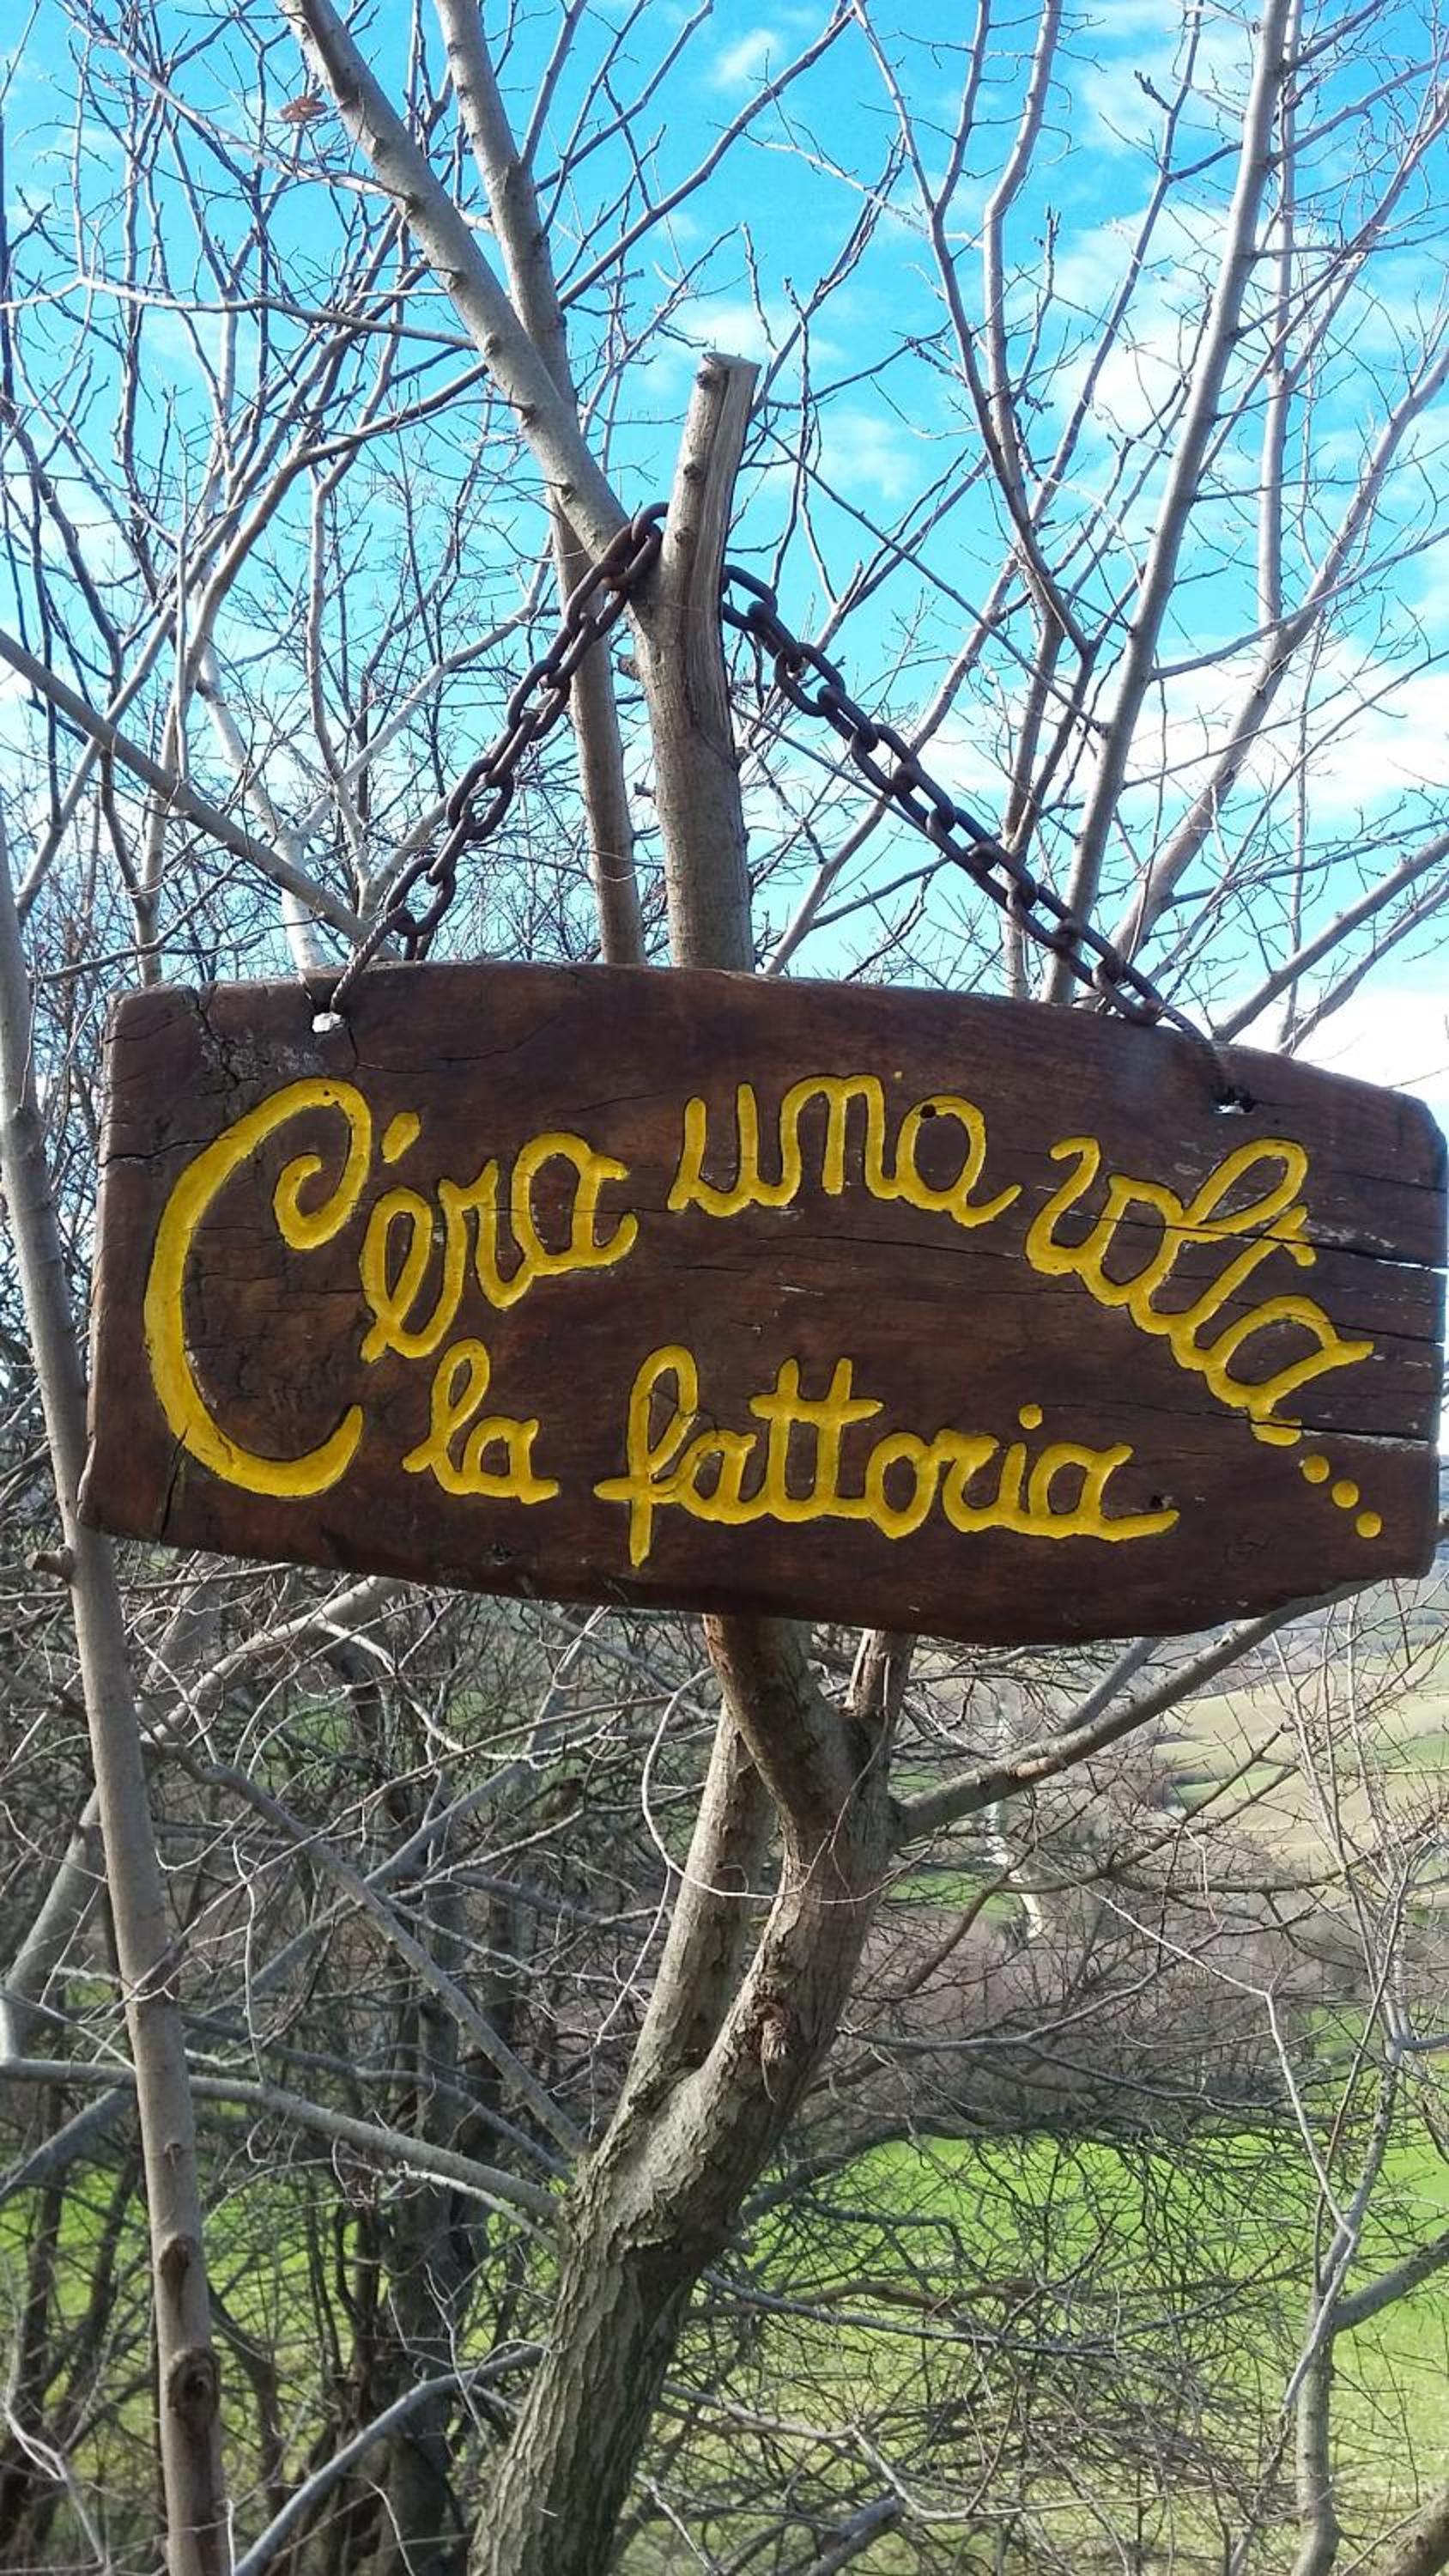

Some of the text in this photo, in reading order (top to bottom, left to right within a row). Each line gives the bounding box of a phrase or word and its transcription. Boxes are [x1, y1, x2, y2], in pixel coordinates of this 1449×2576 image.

[143, 1078, 639, 1499] C'era
[668, 1075, 1022, 1229] una
[402, 1339, 1179, 1568] la fattoria
